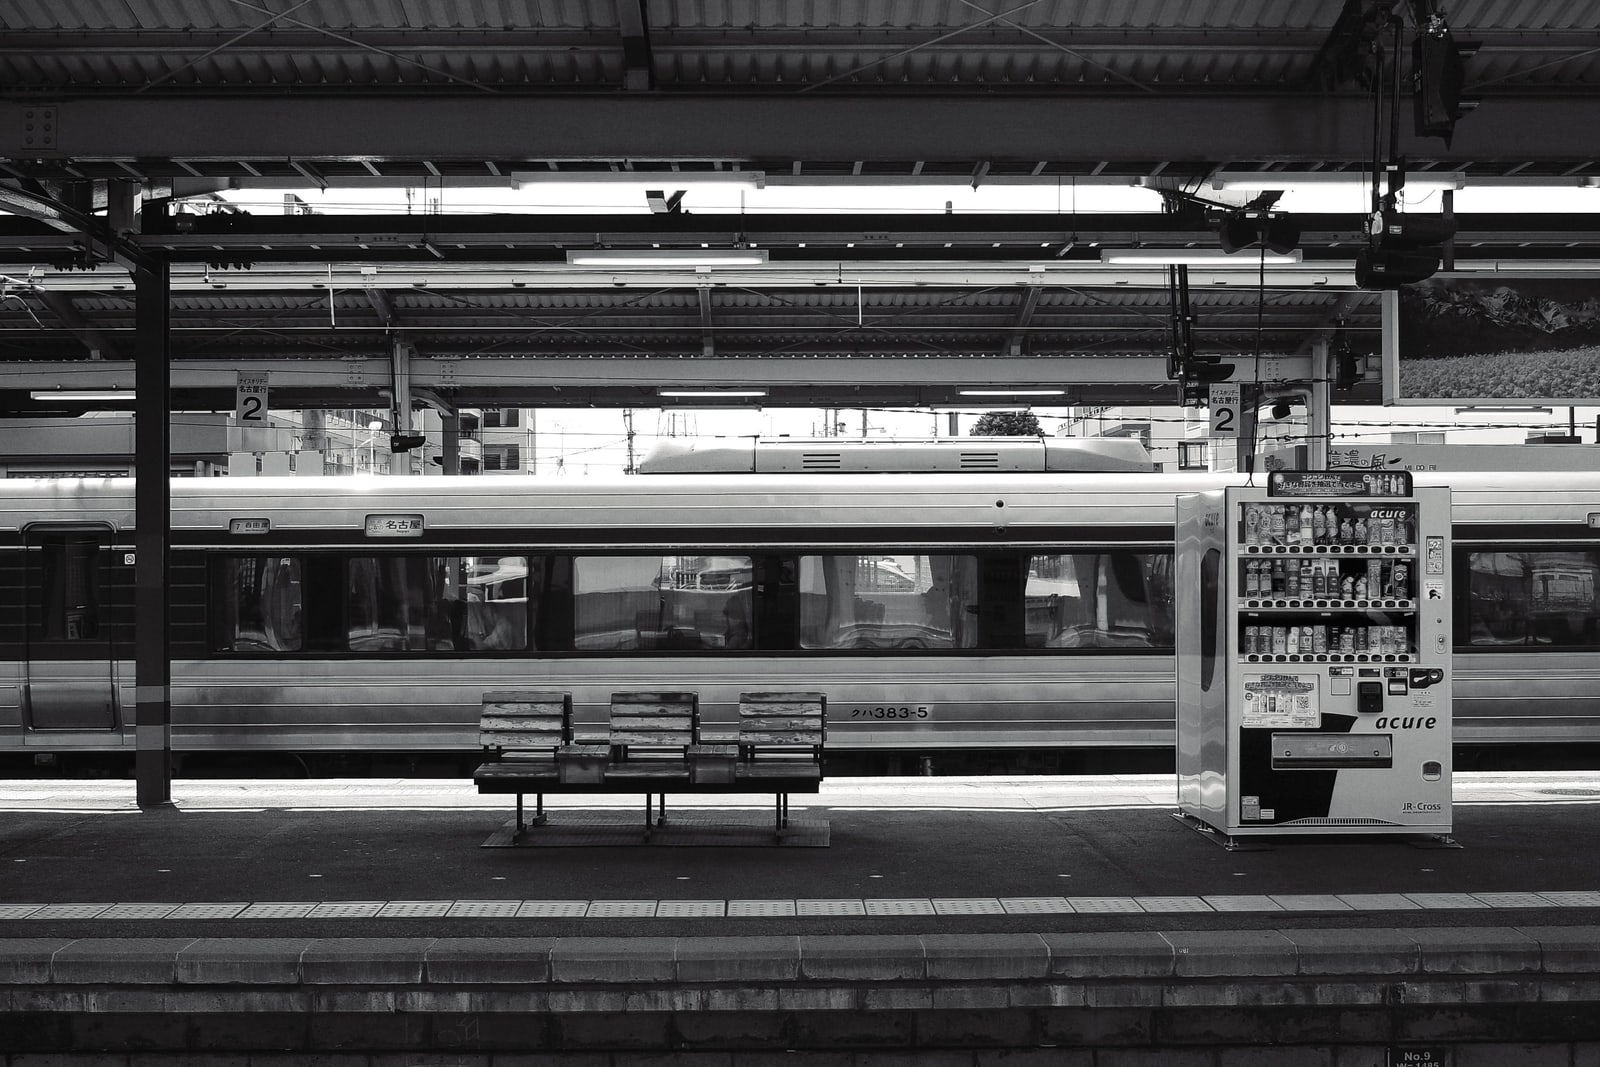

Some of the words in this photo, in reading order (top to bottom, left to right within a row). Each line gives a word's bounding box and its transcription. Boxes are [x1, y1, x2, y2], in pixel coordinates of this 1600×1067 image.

[239, 385, 267, 393] 名古屋行
[1211, 397, 1239, 405] 名古屋行
[242, 396, 262, 421] 2
[1214, 407, 1234, 431] 2
[1370, 509, 1406, 519] acure
[385, 520, 422, 530] 名古屋
[851, 707, 928, 719] クハ383-5
[1375, 716, 1437, 730] acure
[1402, 802, 1441, 811] JR-Cross
[1404, 1051, 1431, 1061] No.9
